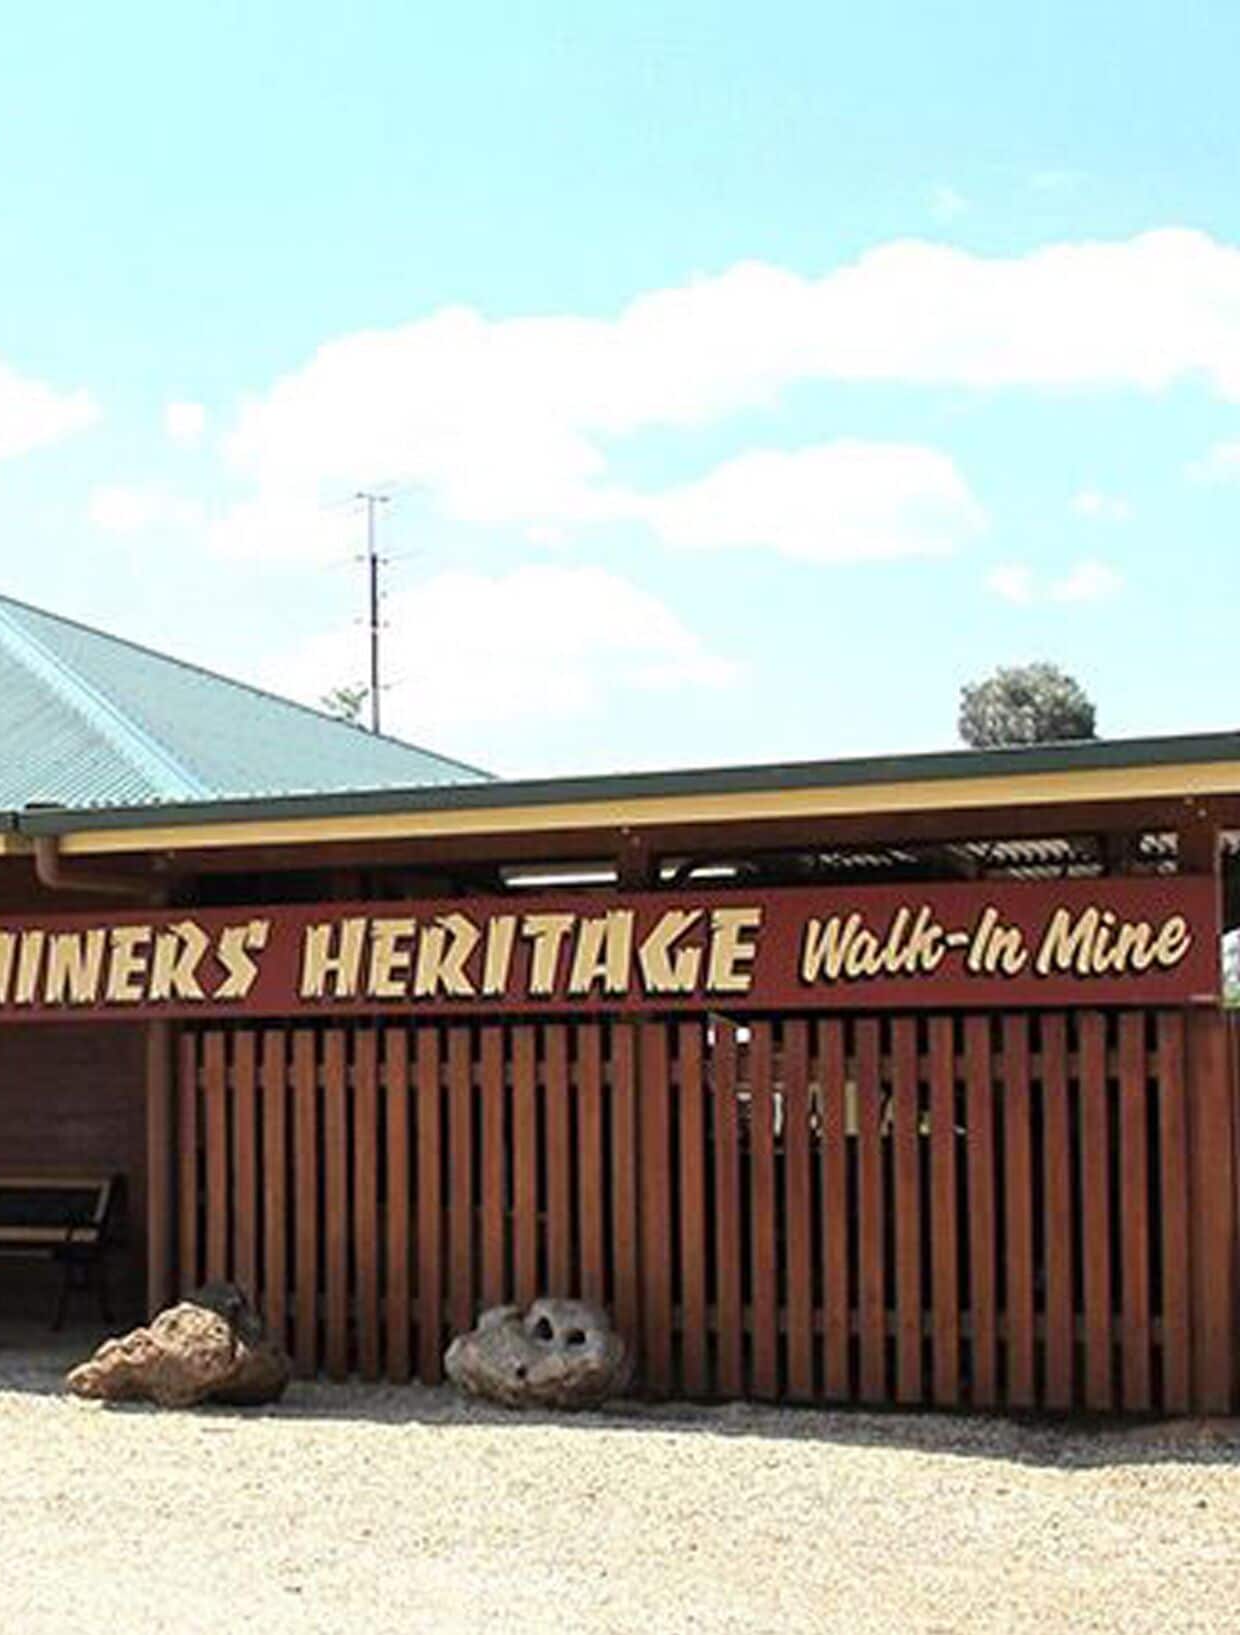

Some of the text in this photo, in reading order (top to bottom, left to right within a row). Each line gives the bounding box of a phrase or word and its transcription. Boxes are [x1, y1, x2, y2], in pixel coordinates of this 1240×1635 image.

[300, 907, 762, 998] HERITAGE
[801, 905, 1028, 984] Walk-In
[1036, 907, 1192, 978] Mine
